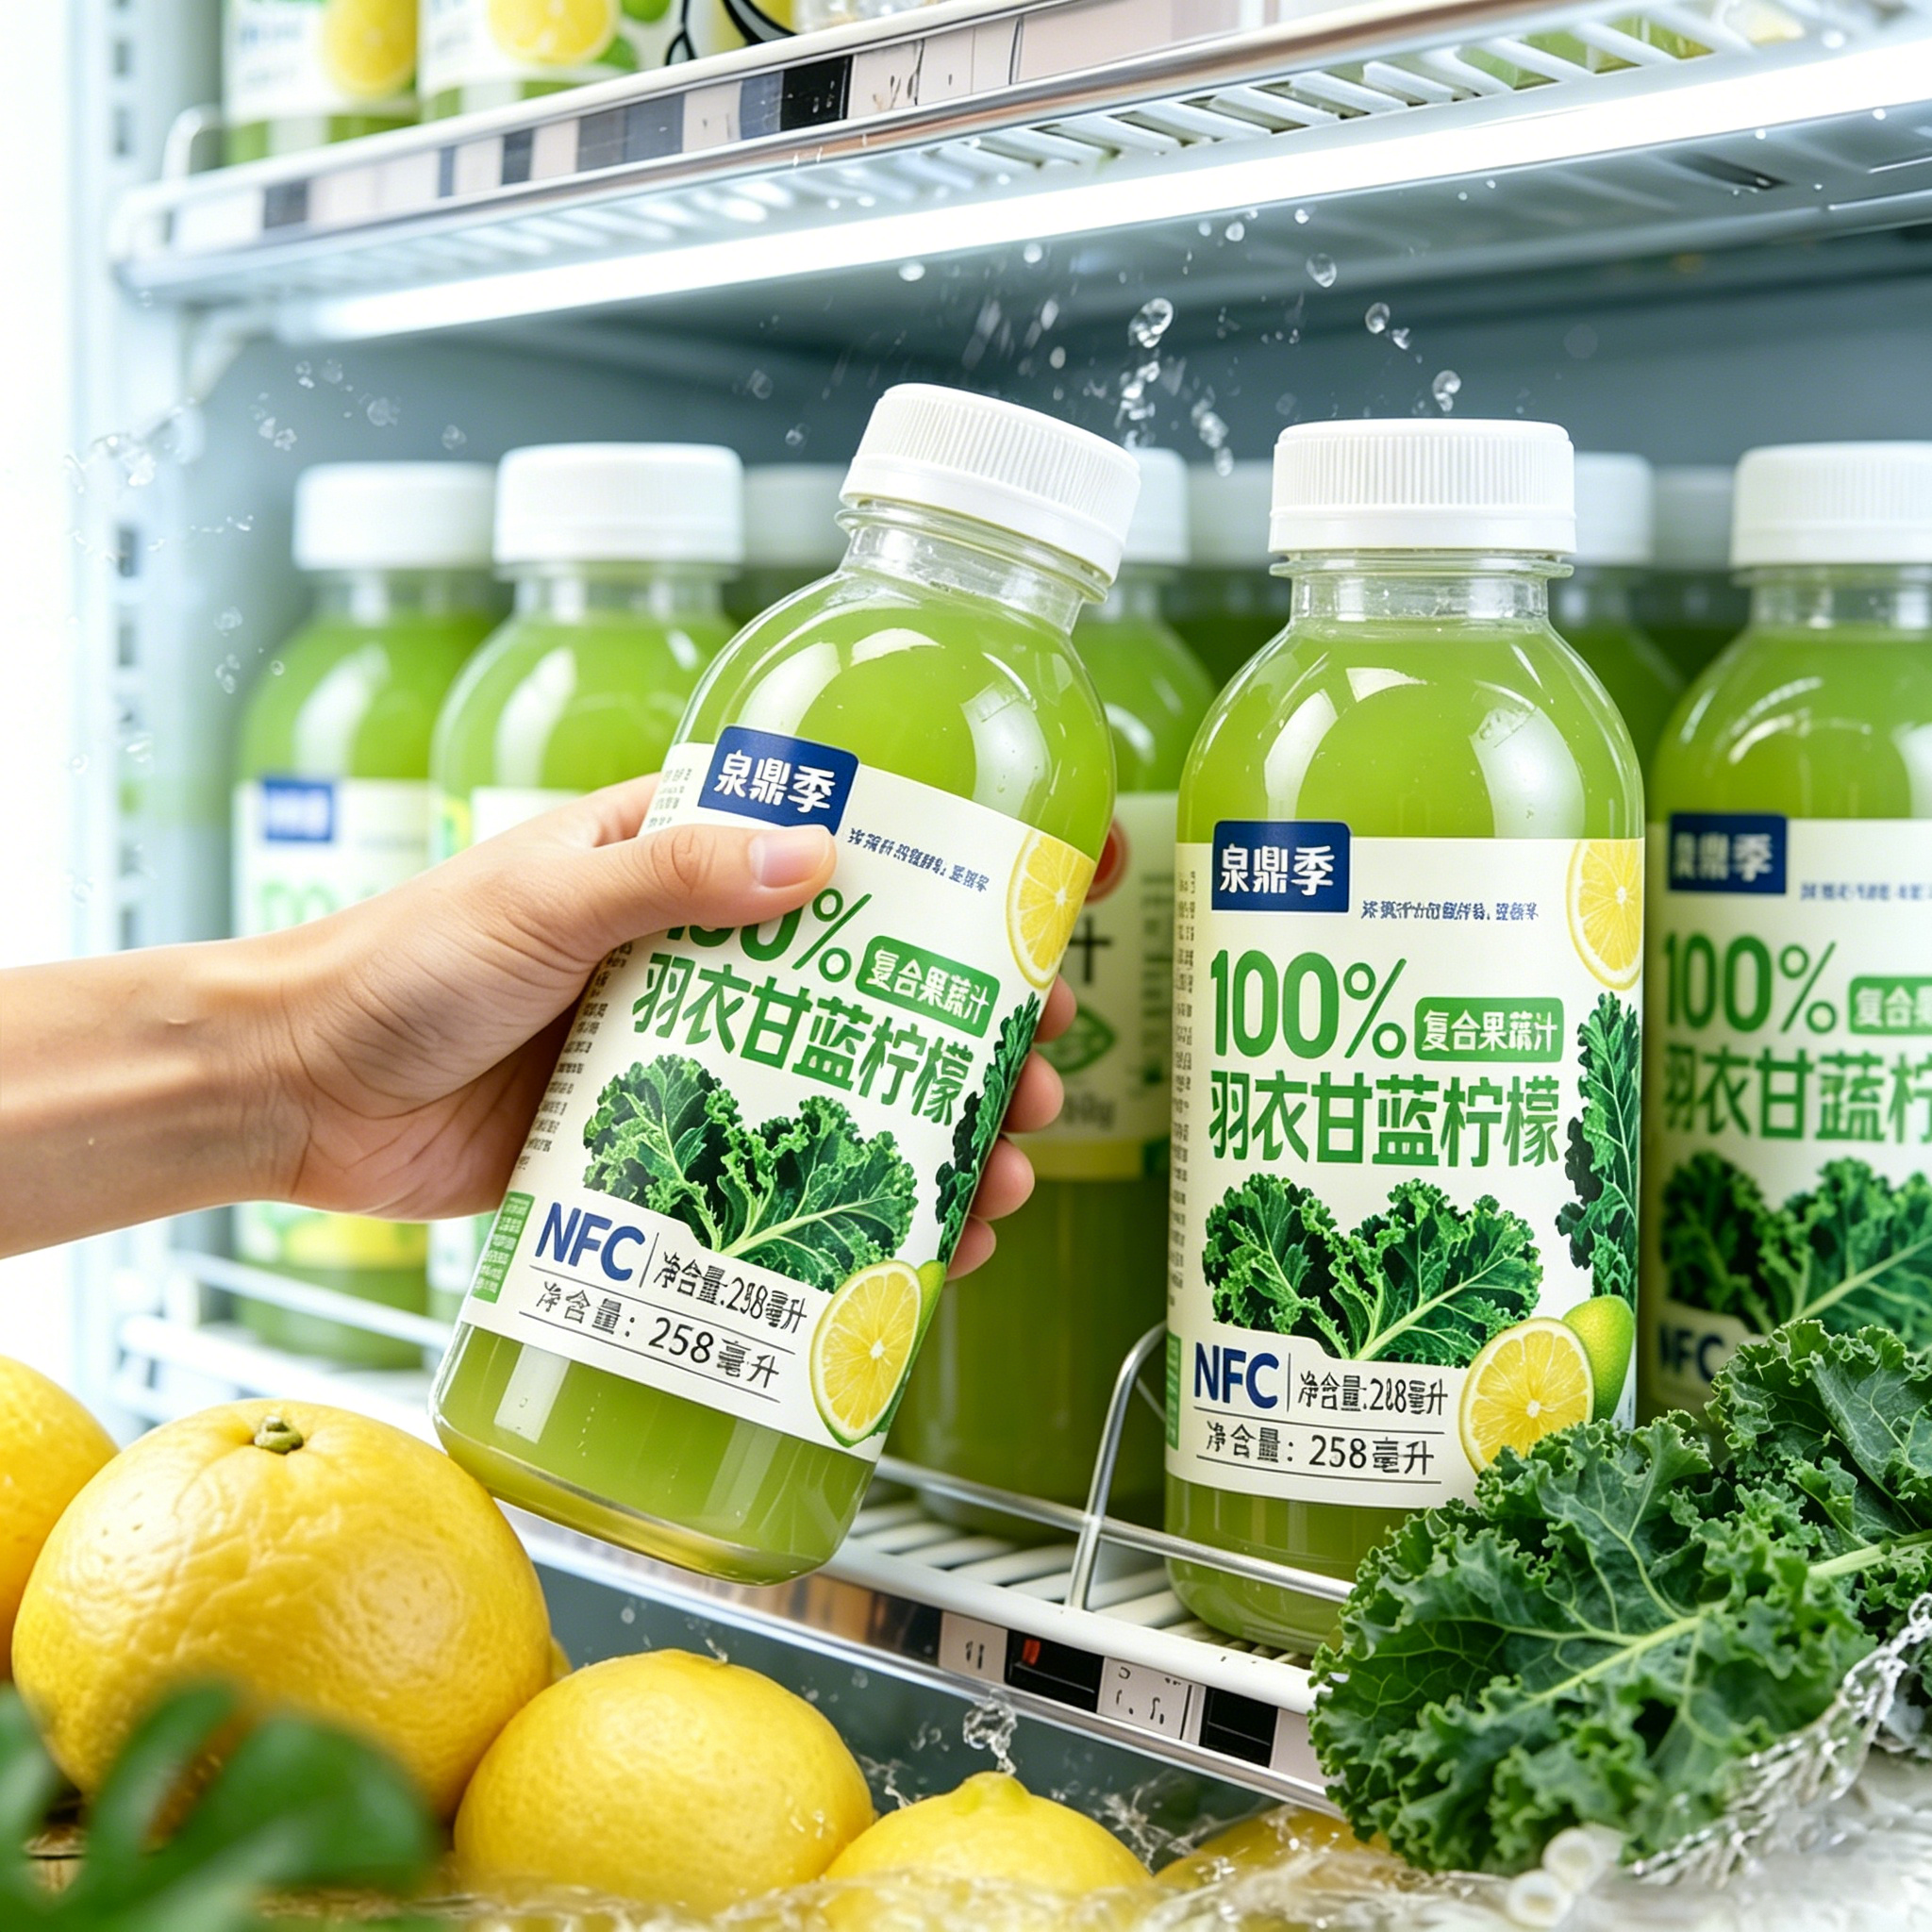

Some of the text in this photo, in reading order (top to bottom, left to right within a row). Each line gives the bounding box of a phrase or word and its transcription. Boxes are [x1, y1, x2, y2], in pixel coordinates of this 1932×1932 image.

[714, 749, 836, 813] 泉鼎季
[1219, 844, 1335, 896] 泉鼎季
[1210, 949, 1558, 1059] 100% 复合果蔬汁
[1664, 932, 1838, 1034] 100%
[632, 952, 974, 1126] 羽衣甘蓝柠檬
[1208, 1069, 1560, 1168] 羽衣甘蓝柠檬
[535, 1202, 646, 1282] NFC
[1193, 1341, 1280, 1409] NFC
